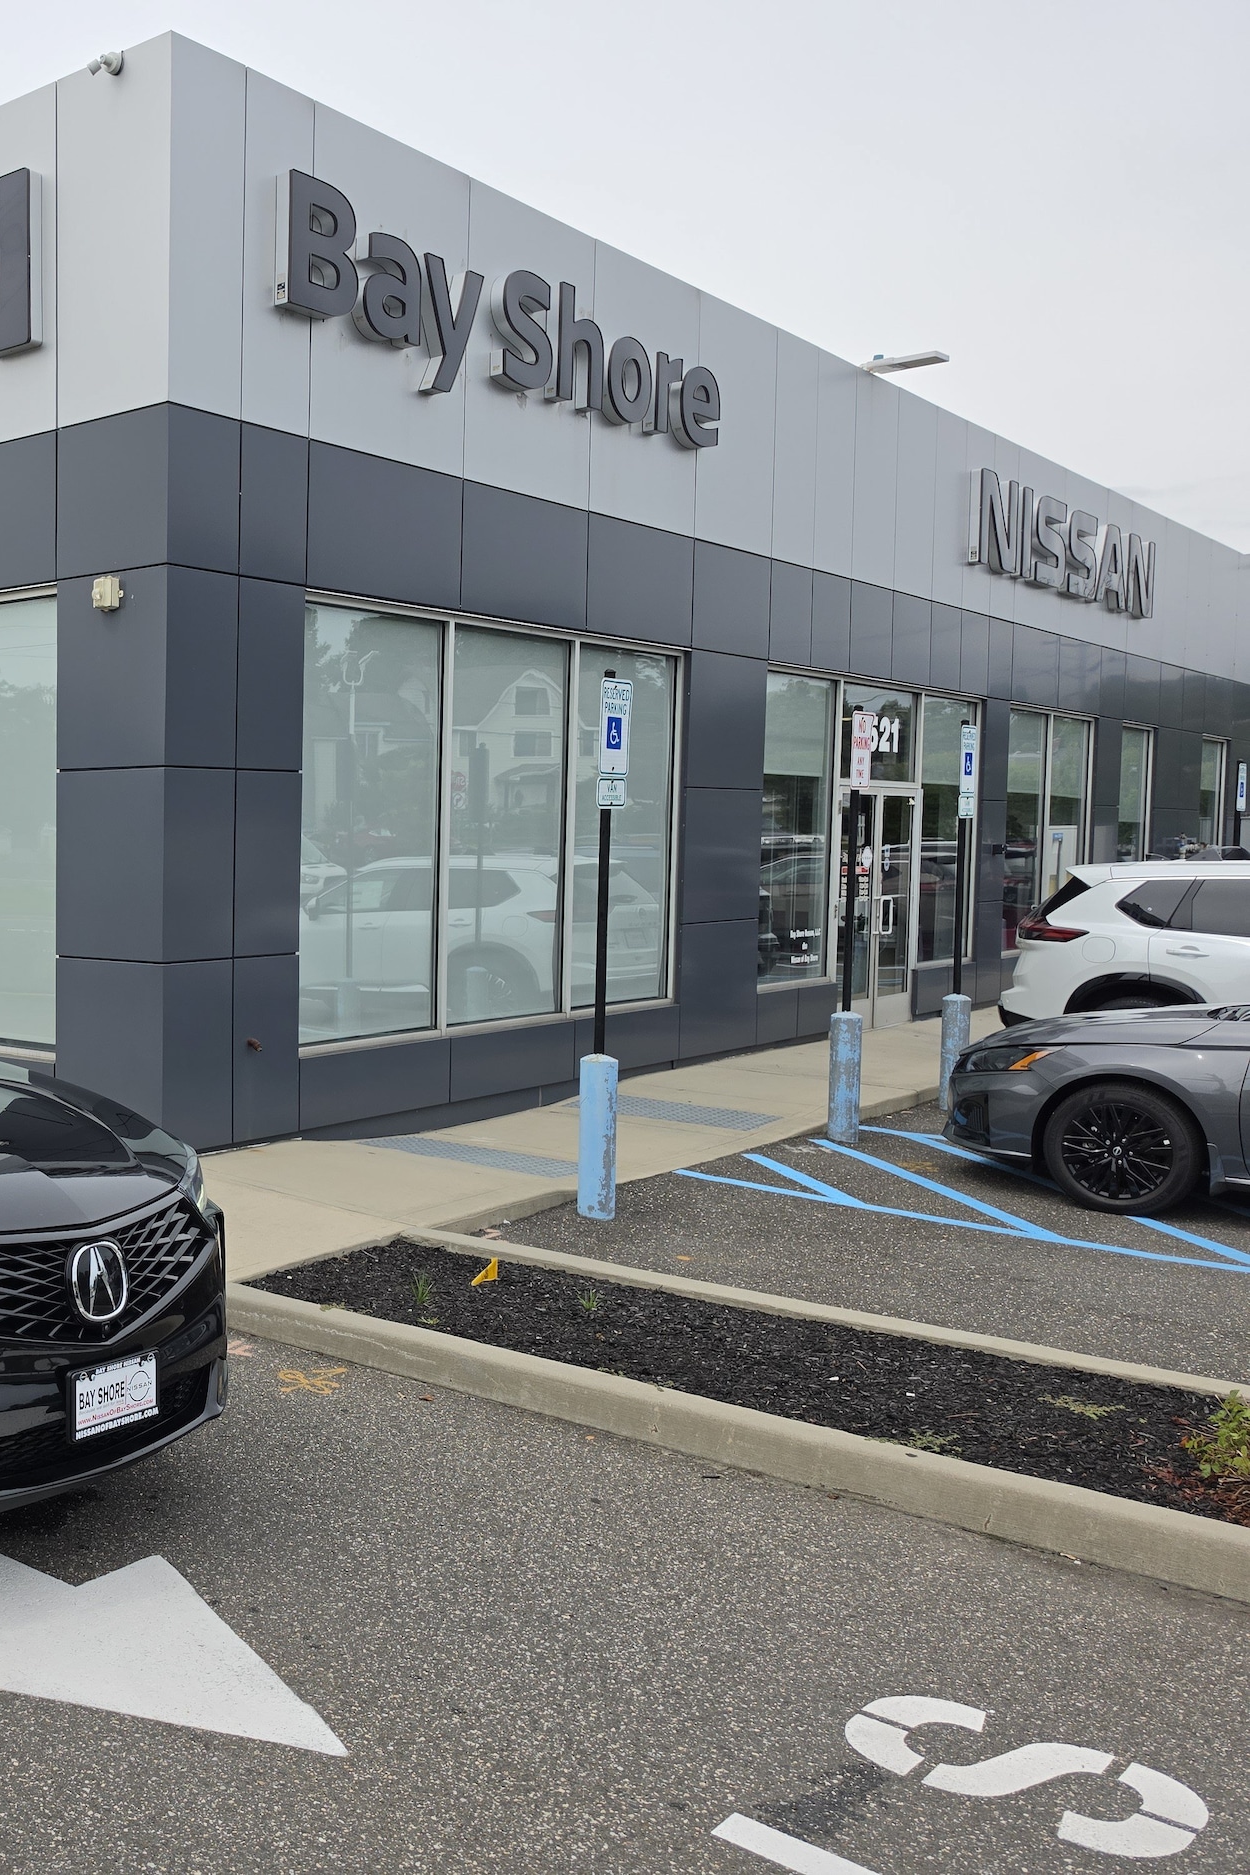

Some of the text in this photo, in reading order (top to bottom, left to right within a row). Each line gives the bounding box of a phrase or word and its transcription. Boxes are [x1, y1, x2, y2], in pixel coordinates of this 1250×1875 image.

[274, 168, 721, 450] Bay Shore
[968, 467, 1156, 618] NISSAN
[603, 686, 630, 701] RESERVED
[604, 701, 627, 715] PARKING
[858, 719, 867, 733] NO
[853, 736, 870, 750] PARKING
[857, 756, 865, 765] ANY
[856, 769, 864, 778] TIME
[607, 784, 618, 793] VAN
[126, 1380, 152, 1392] NISSAN
[79, 1381, 125, 1410] BAY SHORE
[76, 1407, 159, 1440] NISSANOFBAYSHORE.COM
